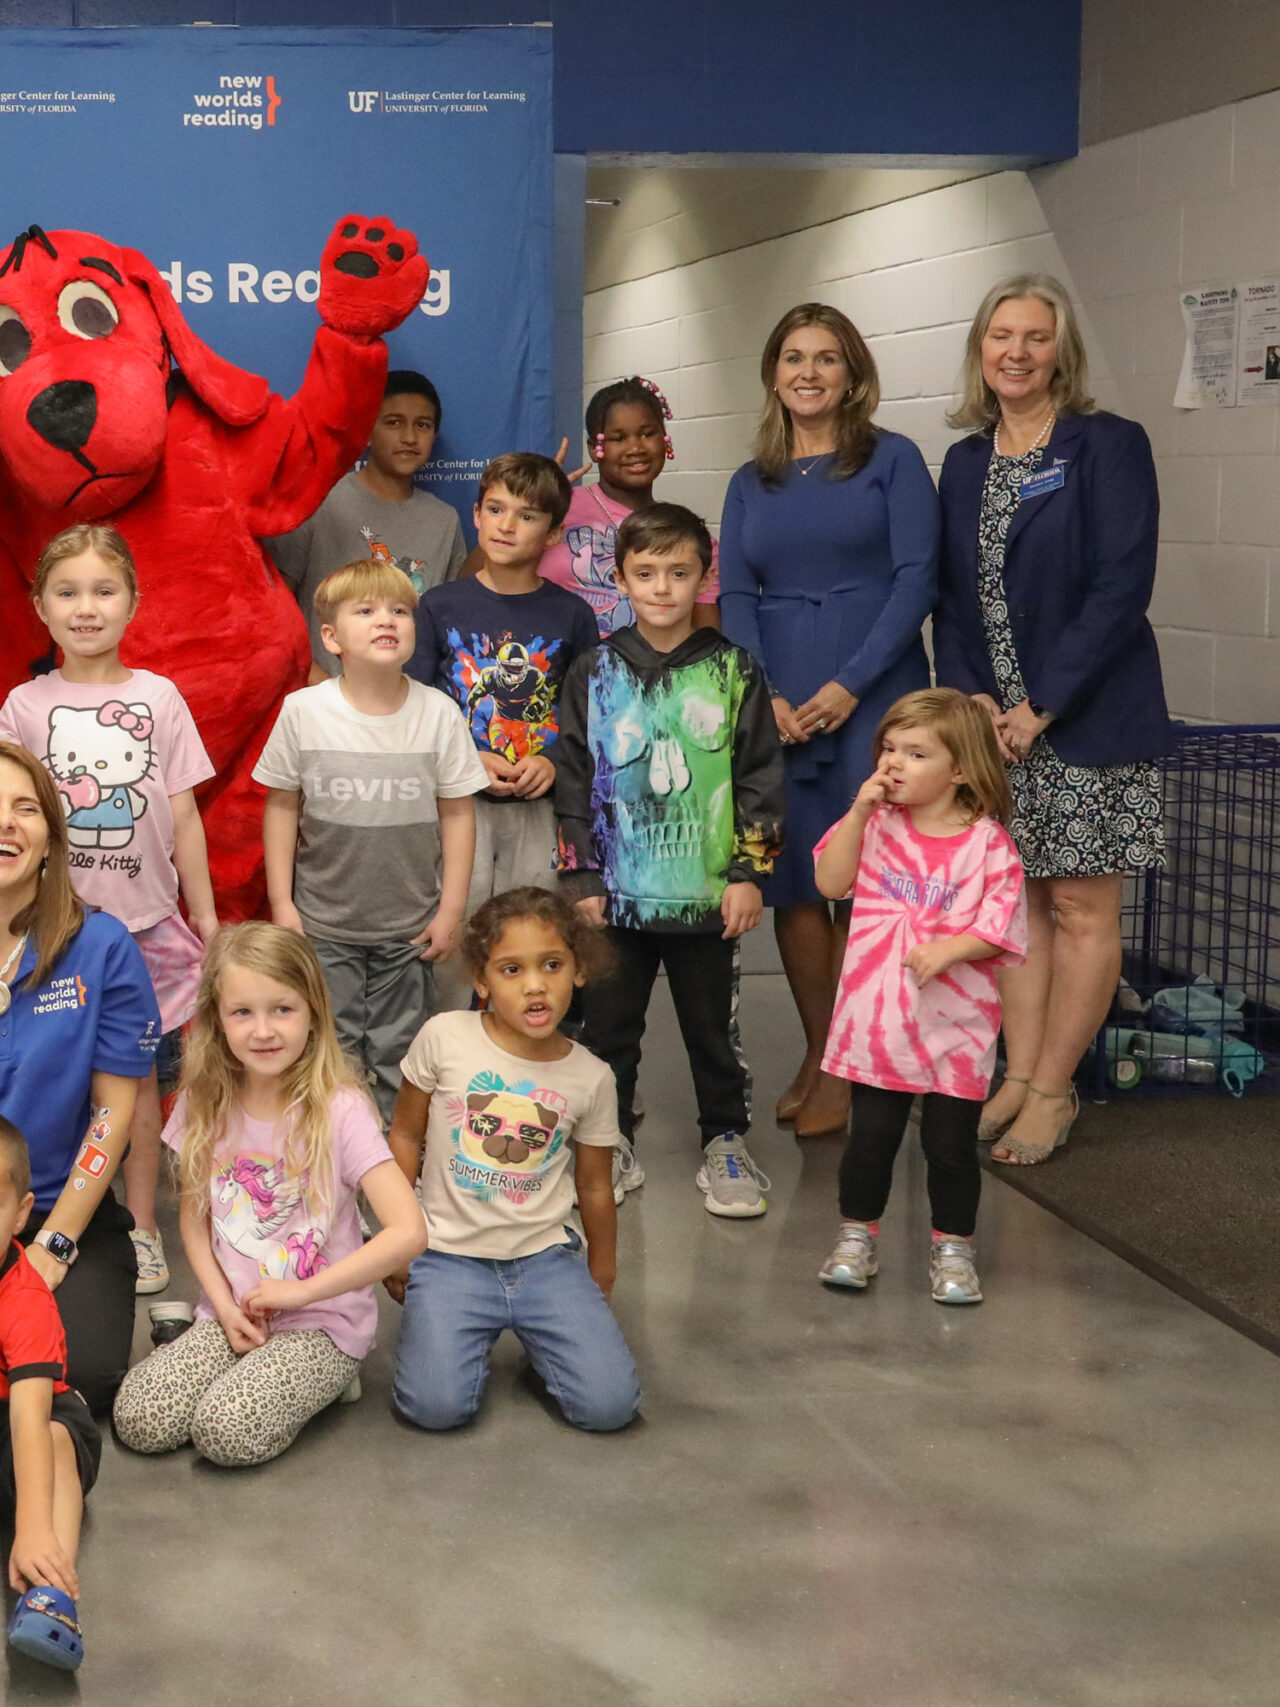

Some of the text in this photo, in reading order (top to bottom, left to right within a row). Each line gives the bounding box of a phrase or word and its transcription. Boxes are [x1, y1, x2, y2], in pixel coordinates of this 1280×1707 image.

[219, 76, 262, 88] new
[18, 90, 51, 100] Center
[54, 90, 68, 100] for
[71, 90, 115, 103] Learning
[193, 91, 263, 107] worlds
[348, 91, 379, 113] UF
[385, 90, 526, 102] Lastinger Center for Learning
[27, 104, 36, 114] of
[38, 104, 77, 112] FLORIDA
[440, 104, 449, 114] of
[450, 104, 488, 112] FLORIDA
[183, 109, 263, 130] reading
[436, 459, 463, 469] Center
[470, 458, 483, 468] for
[444, 473, 453, 482] of
[100, 853, 143, 878] Kitty
[51, 976, 75, 989] new
[38, 987, 77, 1003] worlds
[33, 998, 78, 1014] reading
[448, 1158, 543, 1192] SUMMER VIBES
